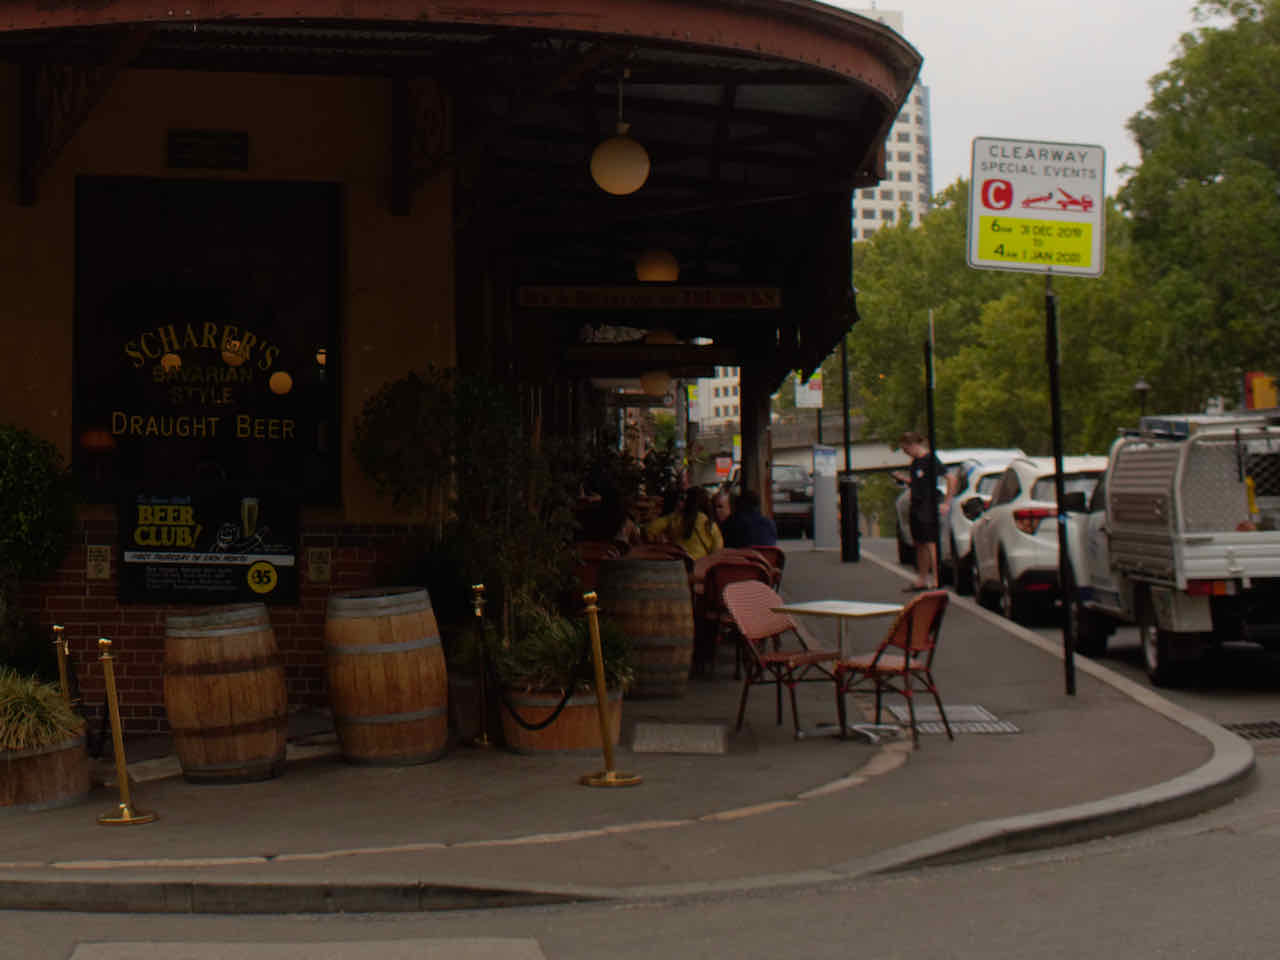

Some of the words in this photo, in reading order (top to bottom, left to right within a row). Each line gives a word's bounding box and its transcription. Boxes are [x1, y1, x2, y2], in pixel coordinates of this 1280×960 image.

[988, 145, 1088, 163] CLEARWAY
[981, 160, 1037, 175] SPECIAL
[1043, 166, 1096, 179] EVENTS
[1032, 225, 1053, 237] DEC
[1057, 227, 1083, 238] 2019
[1031, 250, 1053, 261] JAN
[122, 321, 280, 370] SCHARER'S
[152, 365, 254, 384] BAVARIAN
[168, 384, 233, 406] STYLE
[111, 410, 222, 439] DRAUGHT
[234, 411, 296, 440] BEER
[137, 504, 194, 525] BEER
[133, 524, 201, 547] CLUB!
